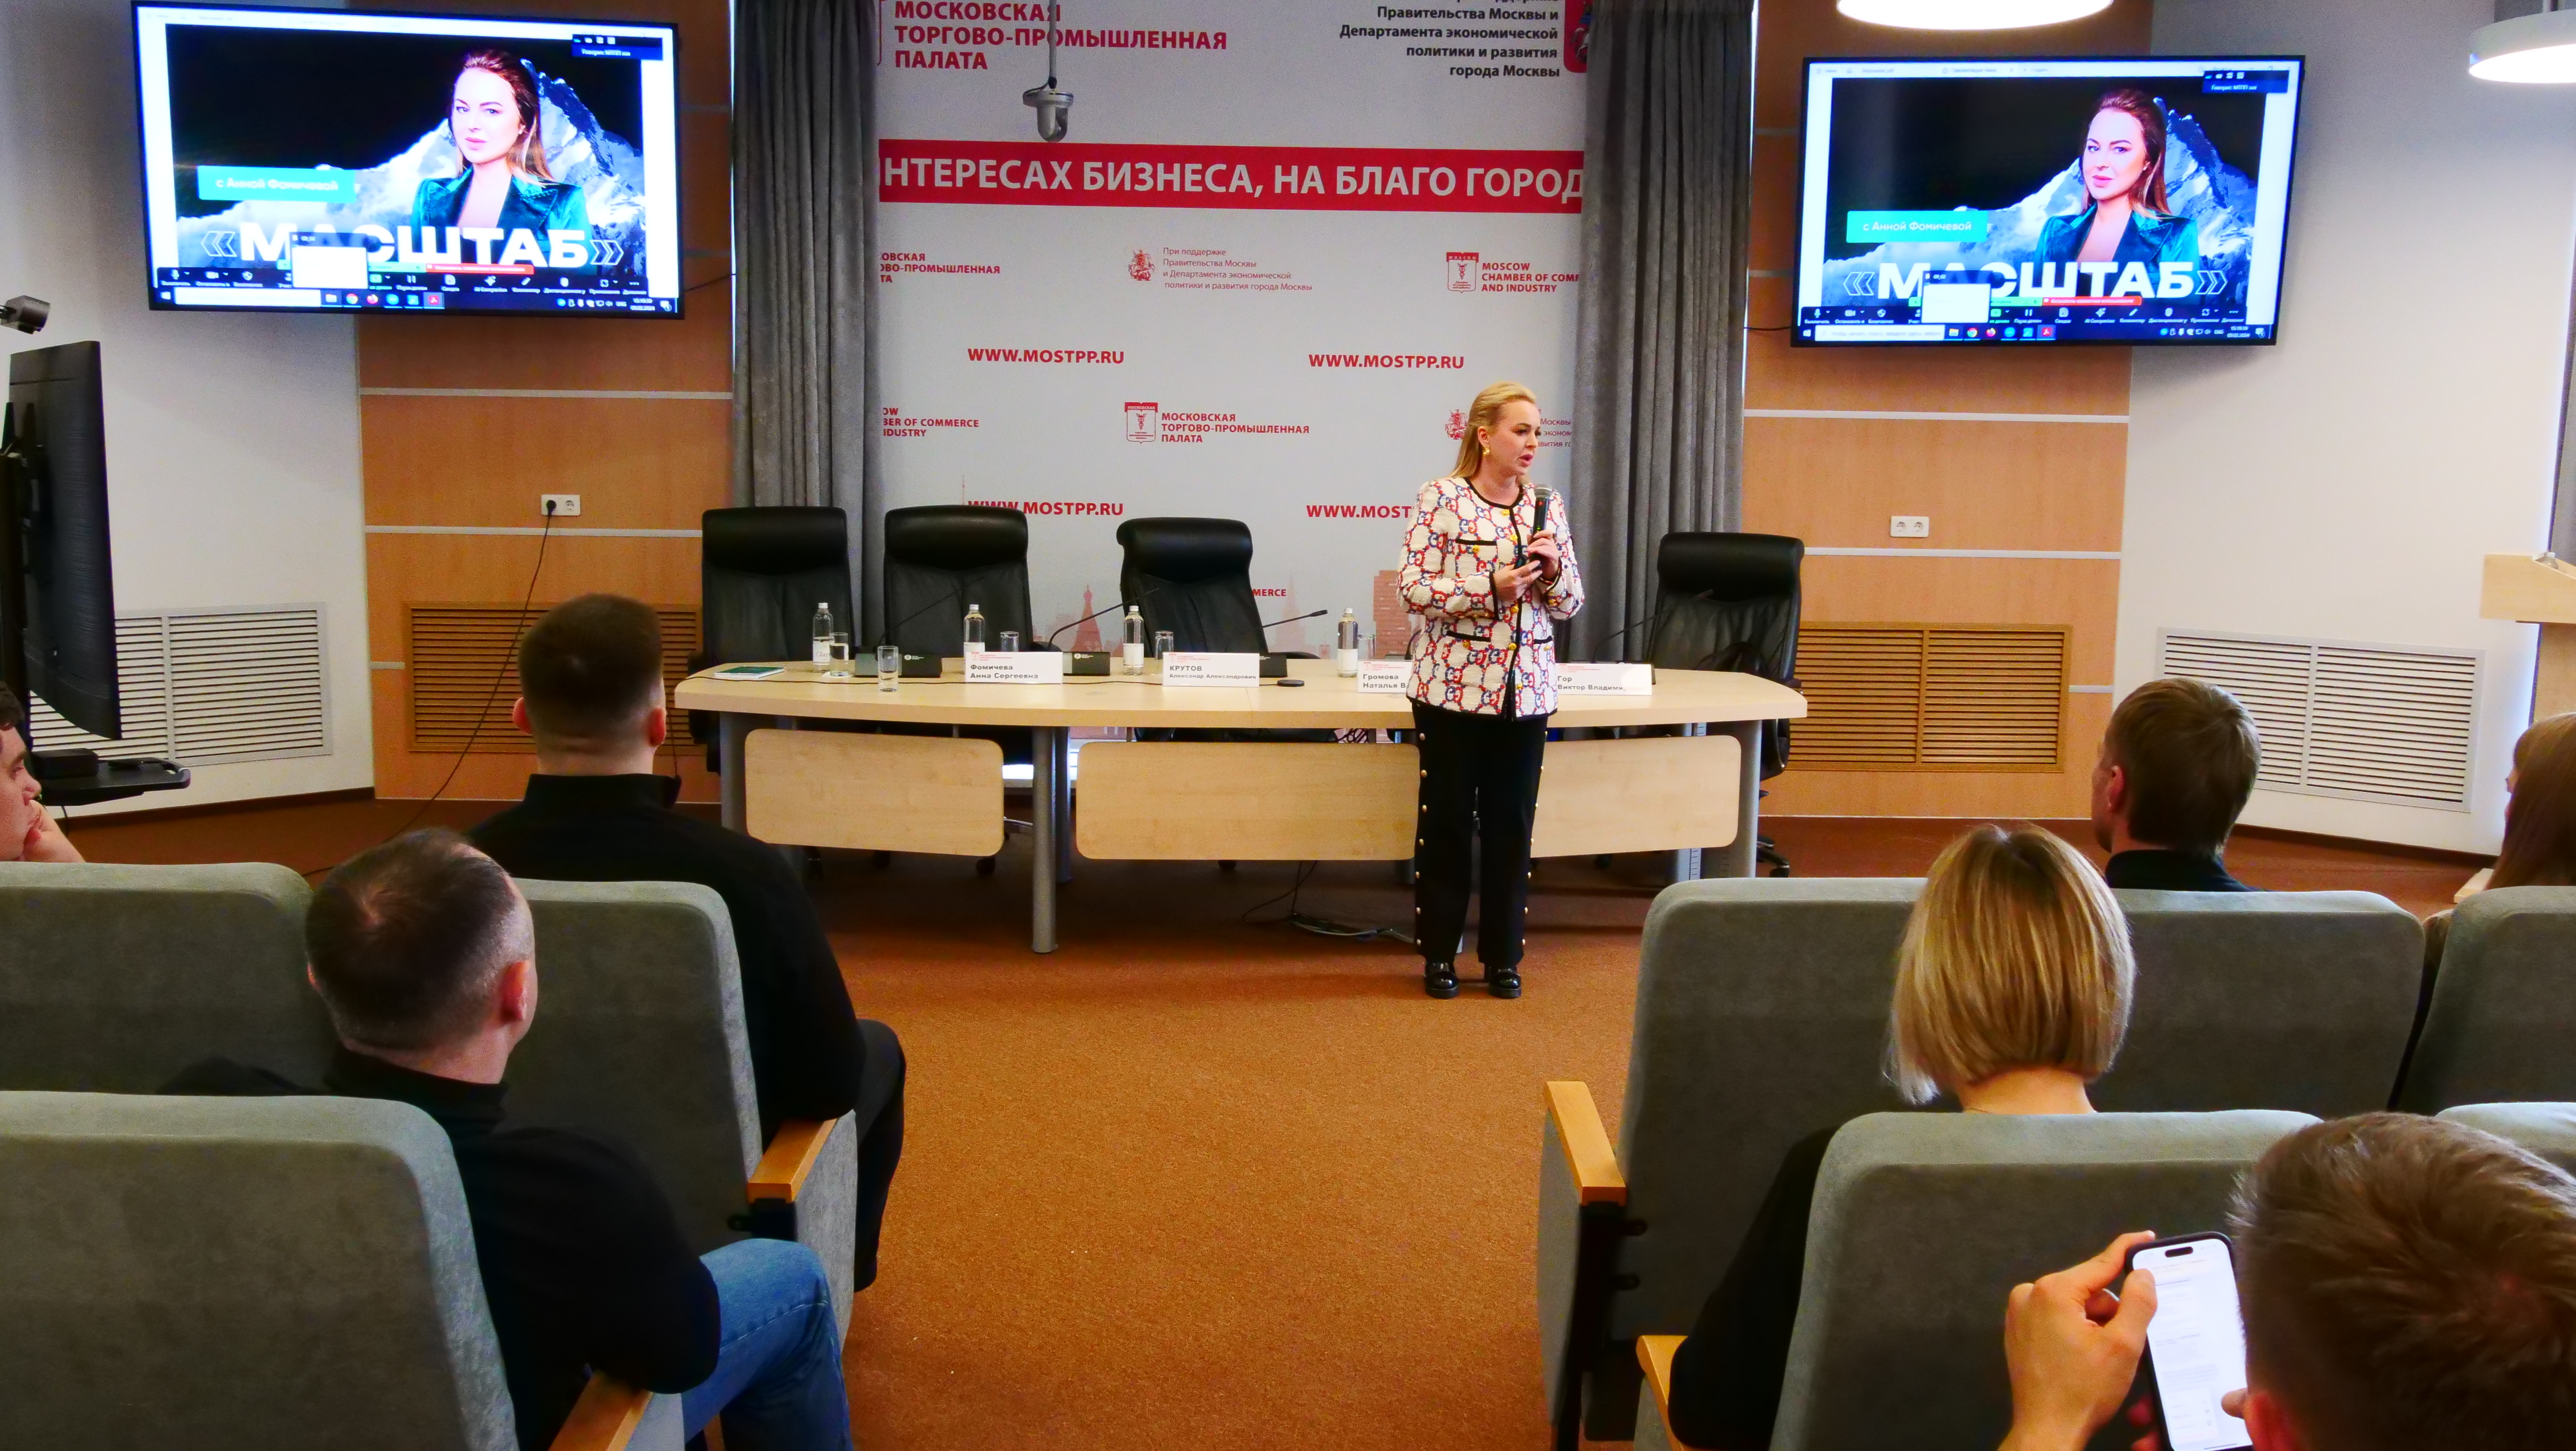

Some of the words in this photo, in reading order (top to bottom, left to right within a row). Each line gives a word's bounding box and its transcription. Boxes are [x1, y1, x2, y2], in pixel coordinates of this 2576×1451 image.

[1377, 6, 1485, 22] Правительства
[1489, 8, 1546, 20] Москвы
[1549, 11, 1558, 20] и
[895, 25, 1227, 49] ТОРГОВО-ПРОМЫШЛЕННАЯ
[1340, 25, 1442, 40] Департамента
[1446, 26, 1558, 40] экономической
[1407, 48, 1474, 58] политики
[1478, 49, 1487, 58] и
[1491, 49, 1557, 60] развития
[895, 51, 988, 70] ПАЛАТА
[1450, 67, 1499, 79] города
[1503, 66, 1560, 77] Москвы
[227, 178, 265, 189] Анной
[268, 179, 338, 191] Фомичевой
[1083, 162, 1263, 197] БИЗНЕСА,
[1275, 165, 1325, 194] НА
[1337, 166, 1456, 196] БЛАГО
[1872, 221, 1907, 231] Анной
[1909, 222, 1972, 232] Фомичевой
[1163, 247, 1179, 256] При
[1163, 258, 1222, 267] Правительства
[1170, 270, 1227, 279] Департамента
[1535, 273, 1548, 282] OF
[967, 348, 1124, 364] WWW.MOSTPP.RU
[1308, 354, 1464, 369] WWW.MOSTPP.RU
[921, 419, 979, 427] COMMERCE
[1162, 412, 1236, 422] МОСКОВСКАЯ
[1162, 423, 1310, 434] ТОРГОВО-ПРОМЫШЛЕННАЯ
[1162, 434, 1203, 443] ПАЛАТА
[1306, 505, 1414, 518] WWW.MOST
